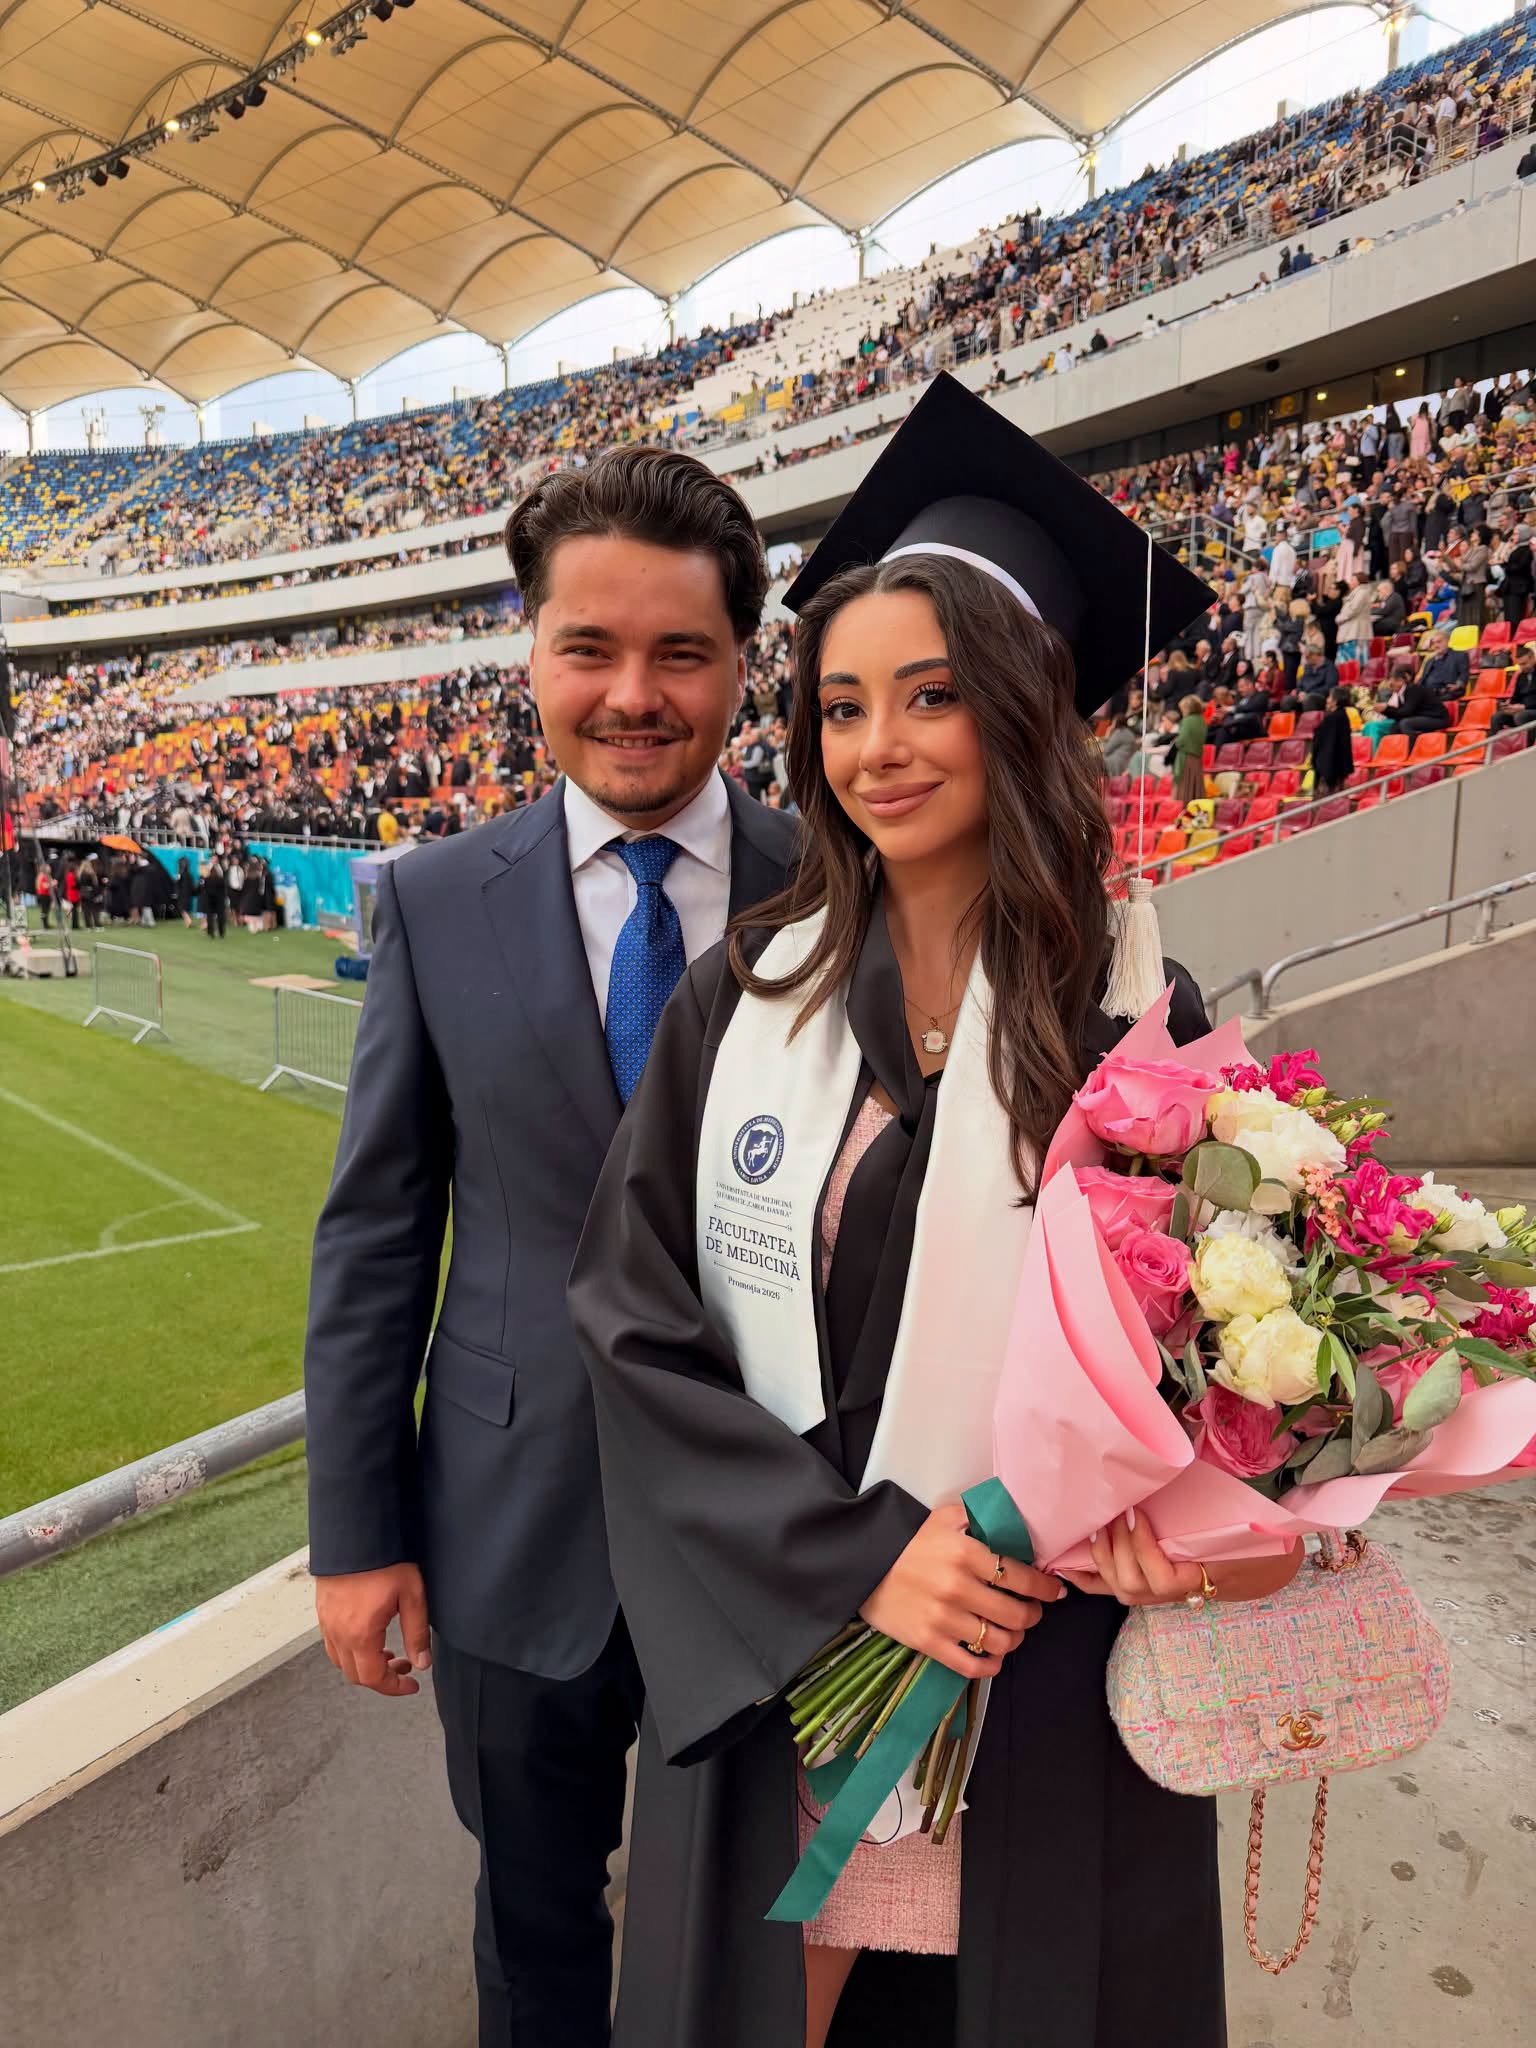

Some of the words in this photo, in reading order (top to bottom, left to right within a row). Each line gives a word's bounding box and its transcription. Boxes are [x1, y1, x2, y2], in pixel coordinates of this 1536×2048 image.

[705, 1235, 723, 1254] DE
[726, 1243, 801, 1281] MEDICINĂ
[708, 1216, 798, 1258] FACULTATEA
